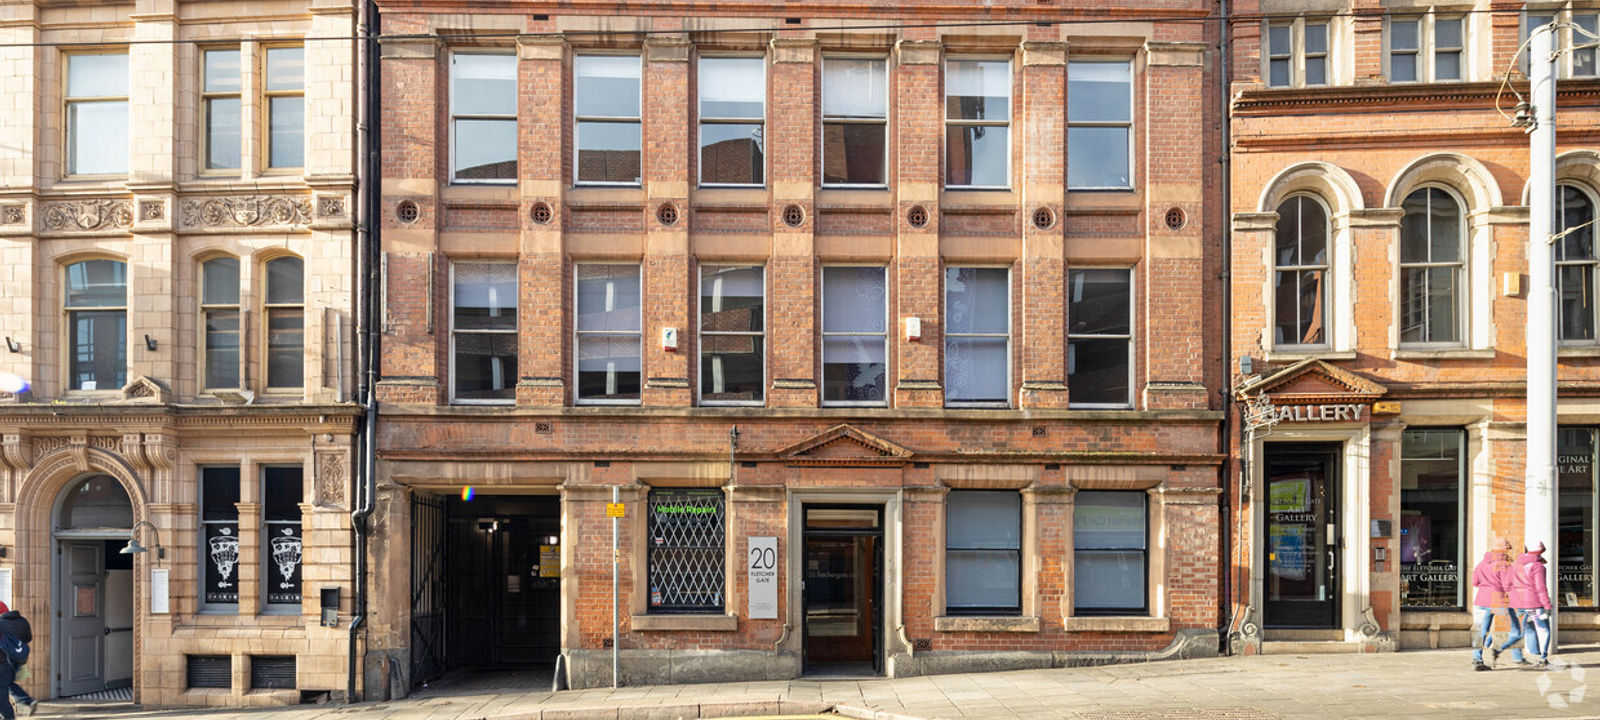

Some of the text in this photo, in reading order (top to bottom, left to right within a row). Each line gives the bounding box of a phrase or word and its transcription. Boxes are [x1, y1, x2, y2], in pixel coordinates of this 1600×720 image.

[1558, 455, 1590, 464] GINAL
[1567, 465, 1588, 473] ART
[656, 505, 717, 514] Mobile Repairs
[1275, 514, 1318, 522] GALLERY
[751, 547, 776, 569] 20
[1420, 573, 1458, 581] GALLERY
